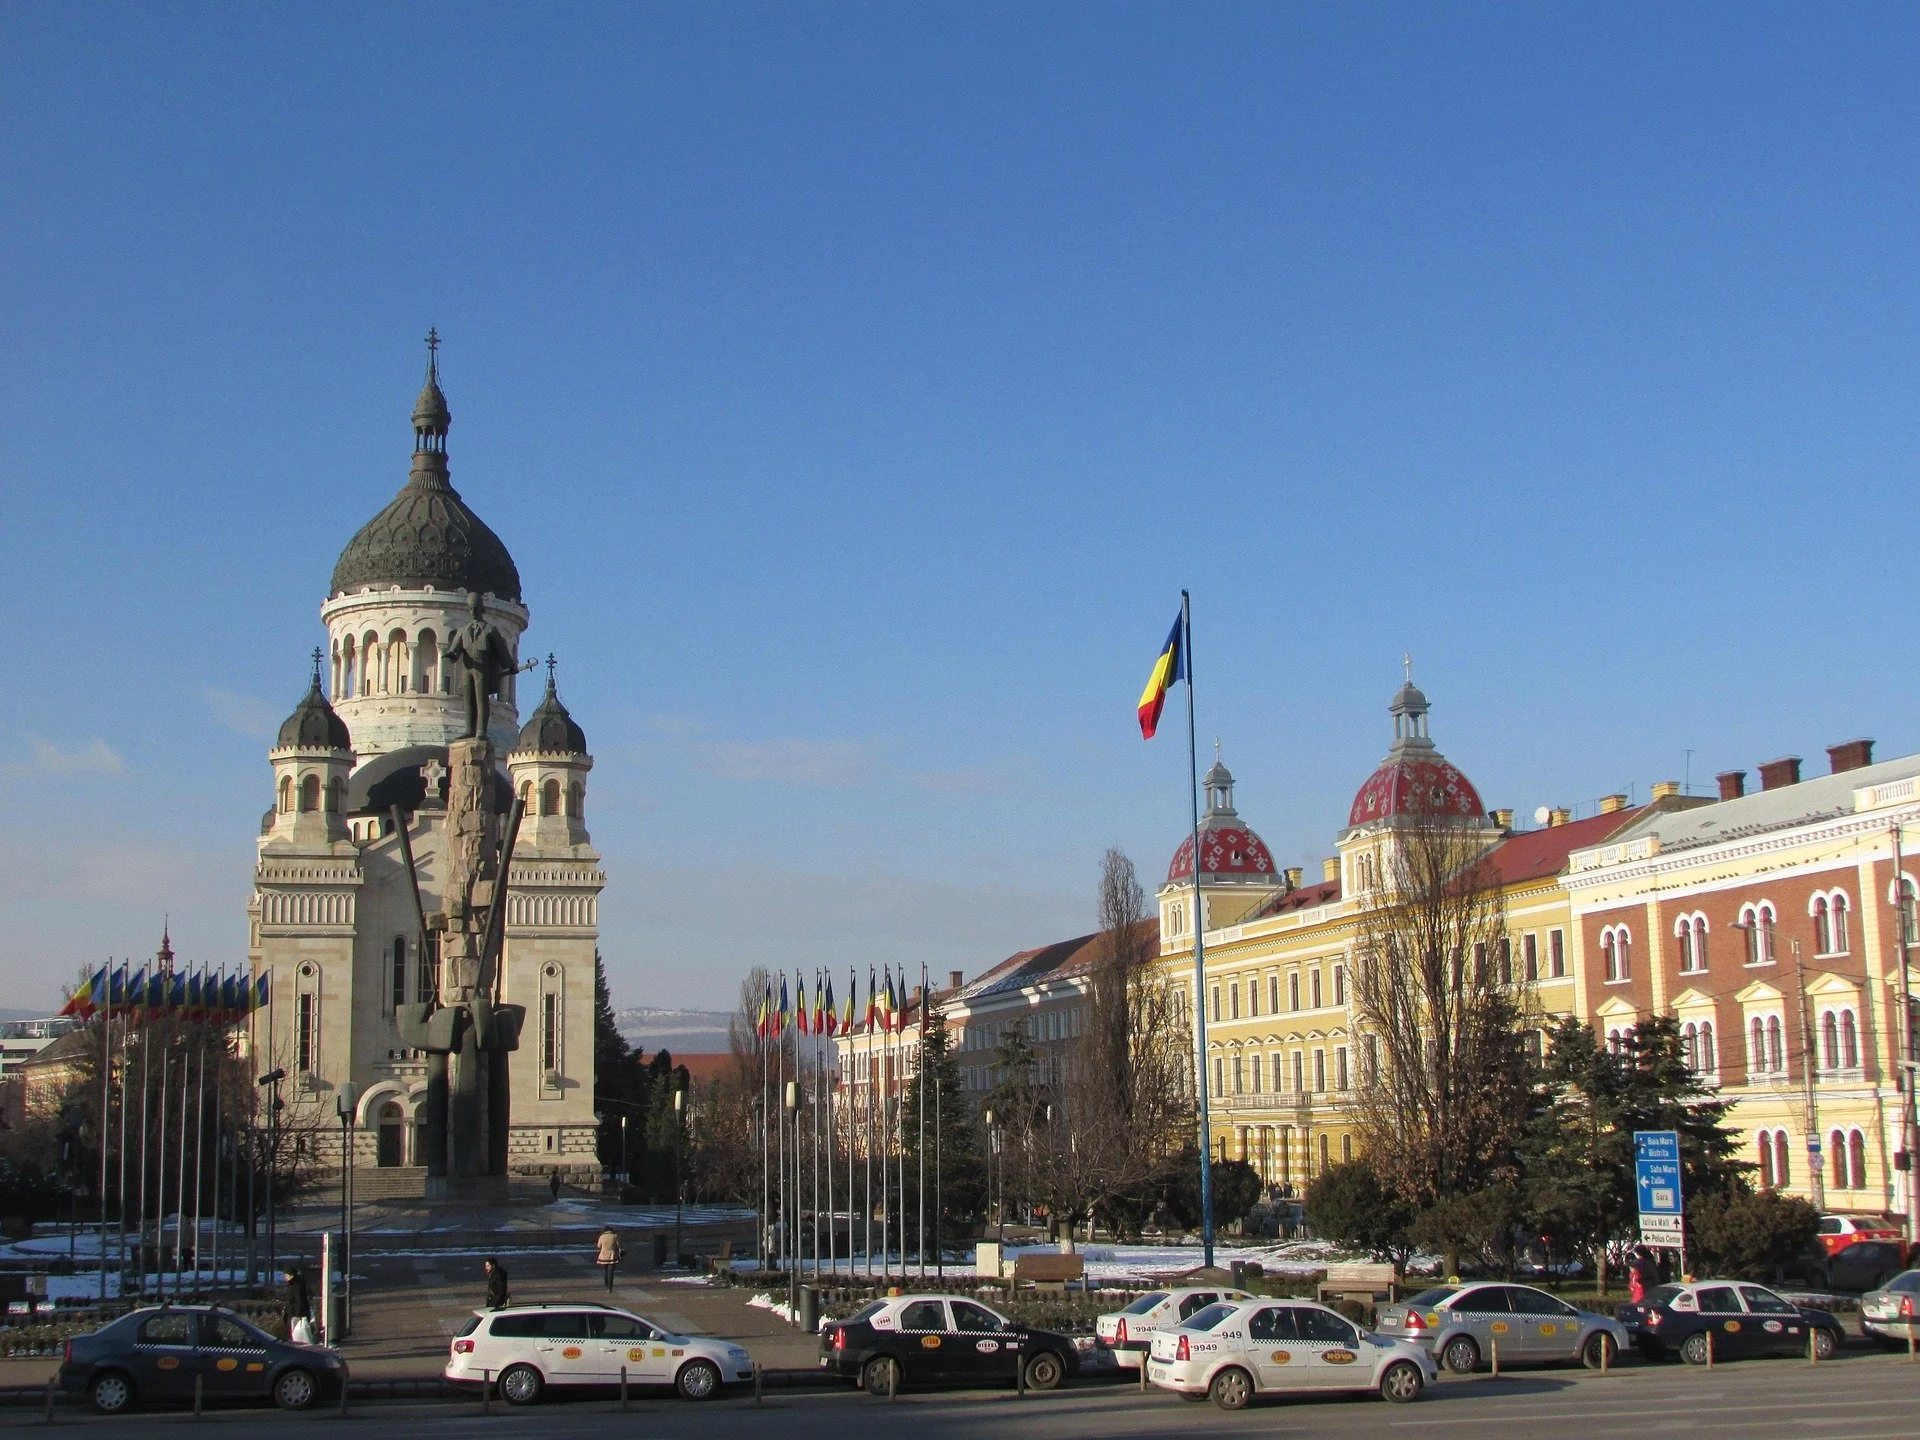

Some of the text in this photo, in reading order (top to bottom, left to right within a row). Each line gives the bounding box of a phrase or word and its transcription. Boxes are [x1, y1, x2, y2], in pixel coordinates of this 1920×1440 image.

[1647, 1137, 1673, 1145] Baia Mare
[1650, 1165, 1676, 1174] Satu Mare
[1656, 1193, 1668, 1201] Gara
[1643, 1218, 1669, 1226] Iulius Mall
[1652, 1234, 1681, 1243] Polus Center
[1222, 1331, 1242, 1339] 949
